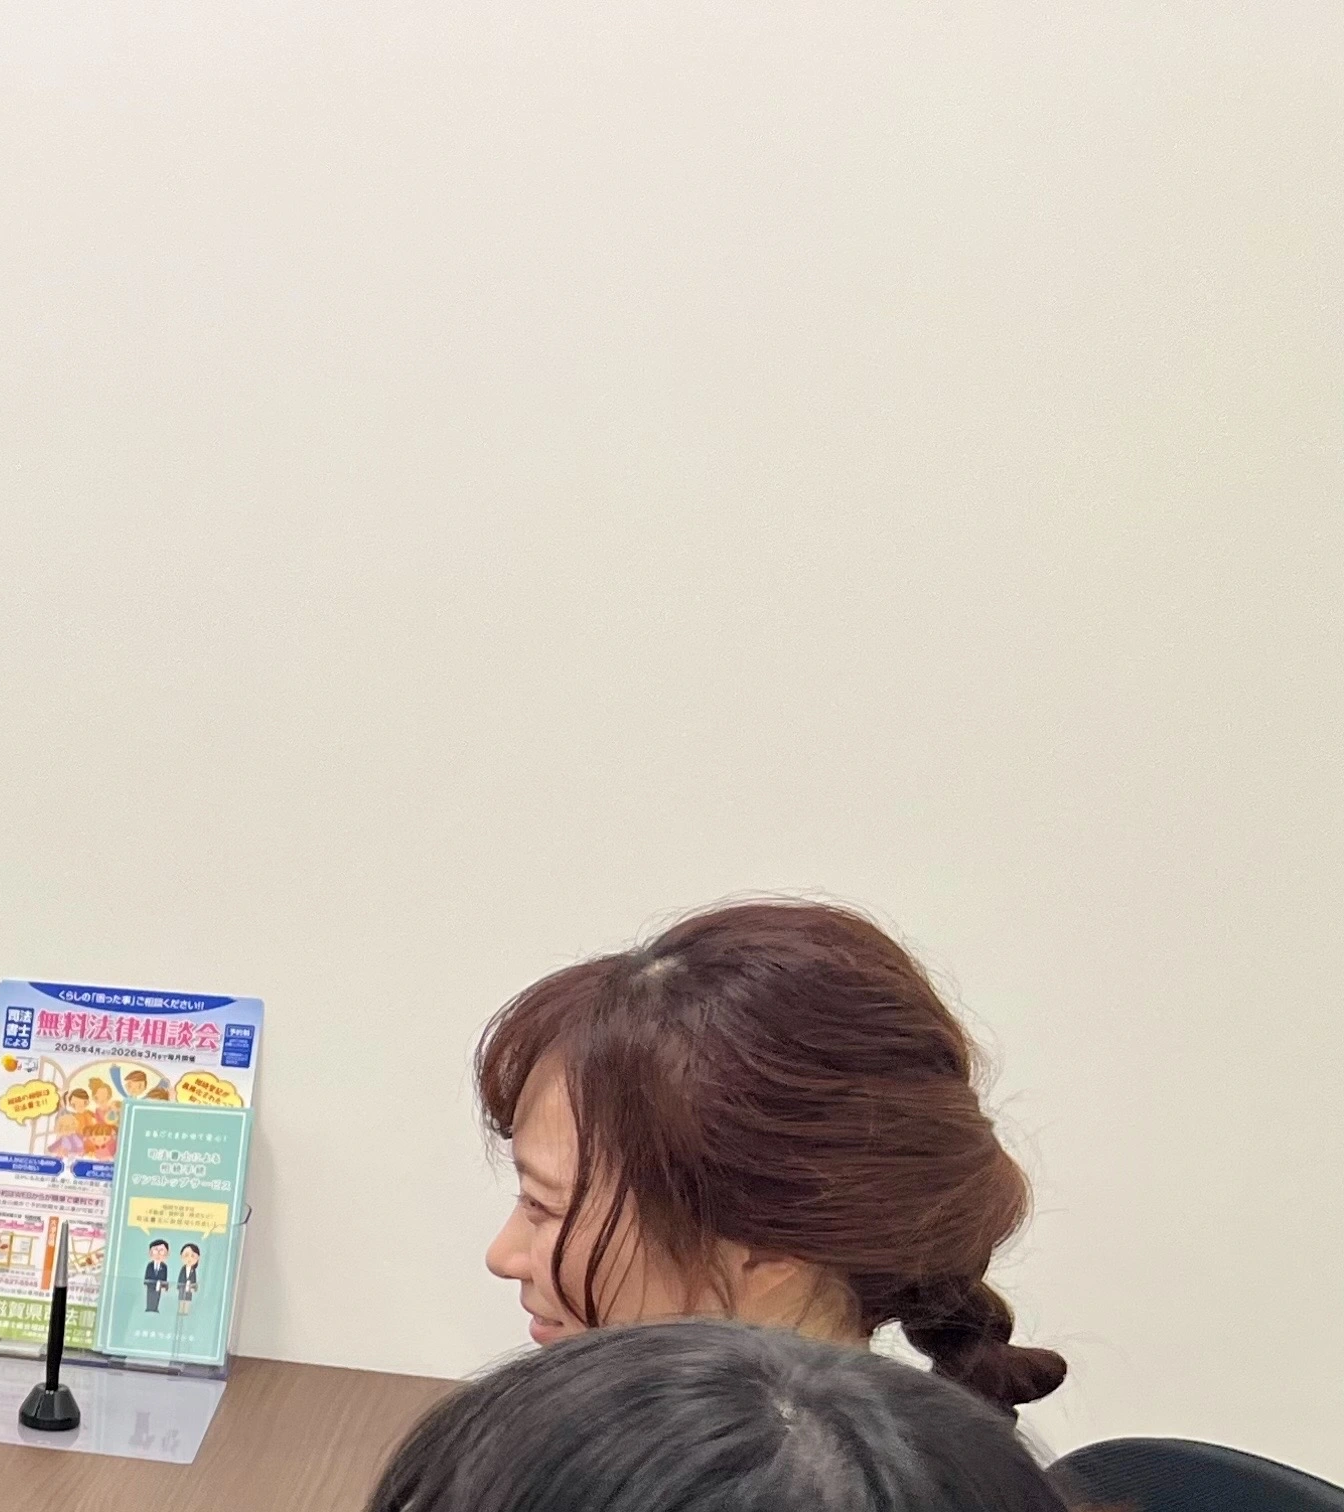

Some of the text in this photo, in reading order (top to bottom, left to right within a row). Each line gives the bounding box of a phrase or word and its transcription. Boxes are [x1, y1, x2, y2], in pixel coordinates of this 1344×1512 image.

[35, 1009, 221, 1051] 無料法律相談会
